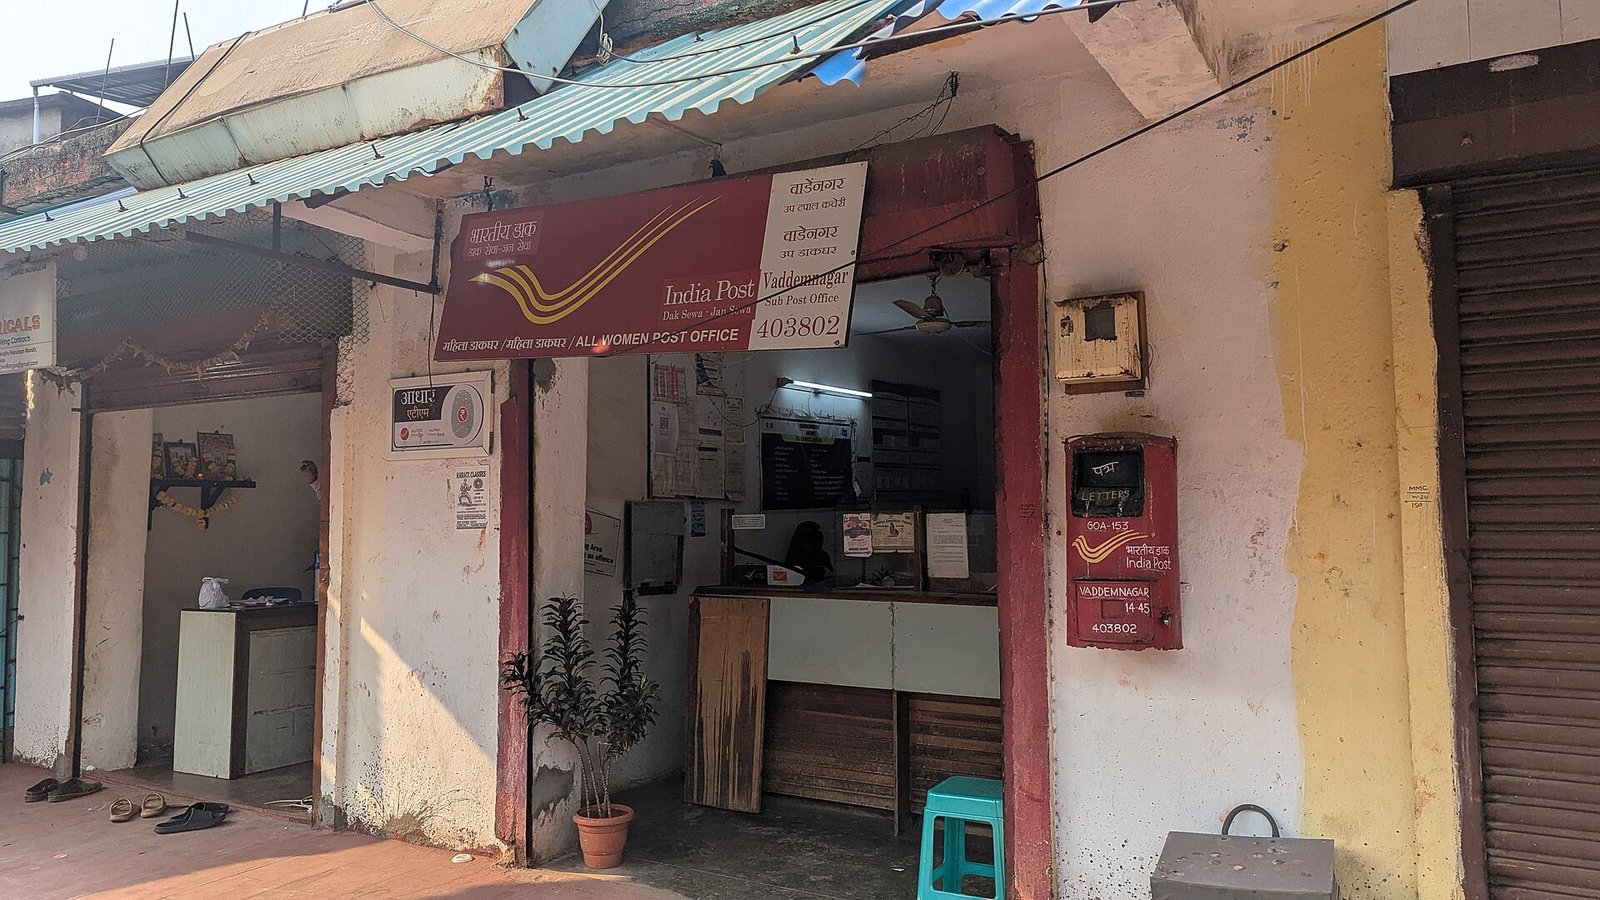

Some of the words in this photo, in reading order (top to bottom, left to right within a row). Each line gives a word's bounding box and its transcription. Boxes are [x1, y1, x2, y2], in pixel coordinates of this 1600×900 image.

[784, 205, 795, 213] उप
[797, 202, 819, 211] टपाल
[821, 196, 846, 209] कचेरी
[470, 221, 512, 244] भारतीय
[512, 221, 537, 238] डाक
[783, 226, 839, 242] वाडेनगर
[468, 248, 481, 257] डाक
[517, 239, 532, 252] सेवा
[780, 250, 795, 258] उप
[798, 245, 838, 257] डाकघर
[664, 282, 711, 306] India
[716, 278, 755, 300] Post
[765, 296, 783, 306] Sub
[786, 295, 807, 305] Post
[810, 293, 839, 304] Office
[663, 311, 679, 320] Dak
[681, 309, 703, 319] Sewa
[710, 307, 727, 317] Jan
[756, 316, 839, 338] 403802
[443, 338, 468, 352] महिला
[469, 341, 499, 351] डाकघर
[535, 338, 567, 349] डाकघर
[602, 333, 649, 346] WOMEN
[652, 331, 687, 344] POST
[690, 328, 739, 342] OFFICE
[401, 389, 435, 405] आधार
[407, 406, 430, 420] एटीएम
[1081, 490, 1130, 501] LETTERS
[1086, 521, 1129, 531] GOA-153
[1126, 543, 1154, 556] भारतीय
[1155, 545, 1170, 556] डाक
[595, 554, 613, 564] offence
[1126, 556, 1152, 569] India
[1153, 556, 1171, 570] Post
[1079, 586, 1150, 598] VADDEMNAGAR
[1092, 623, 1137, 634] 403802
